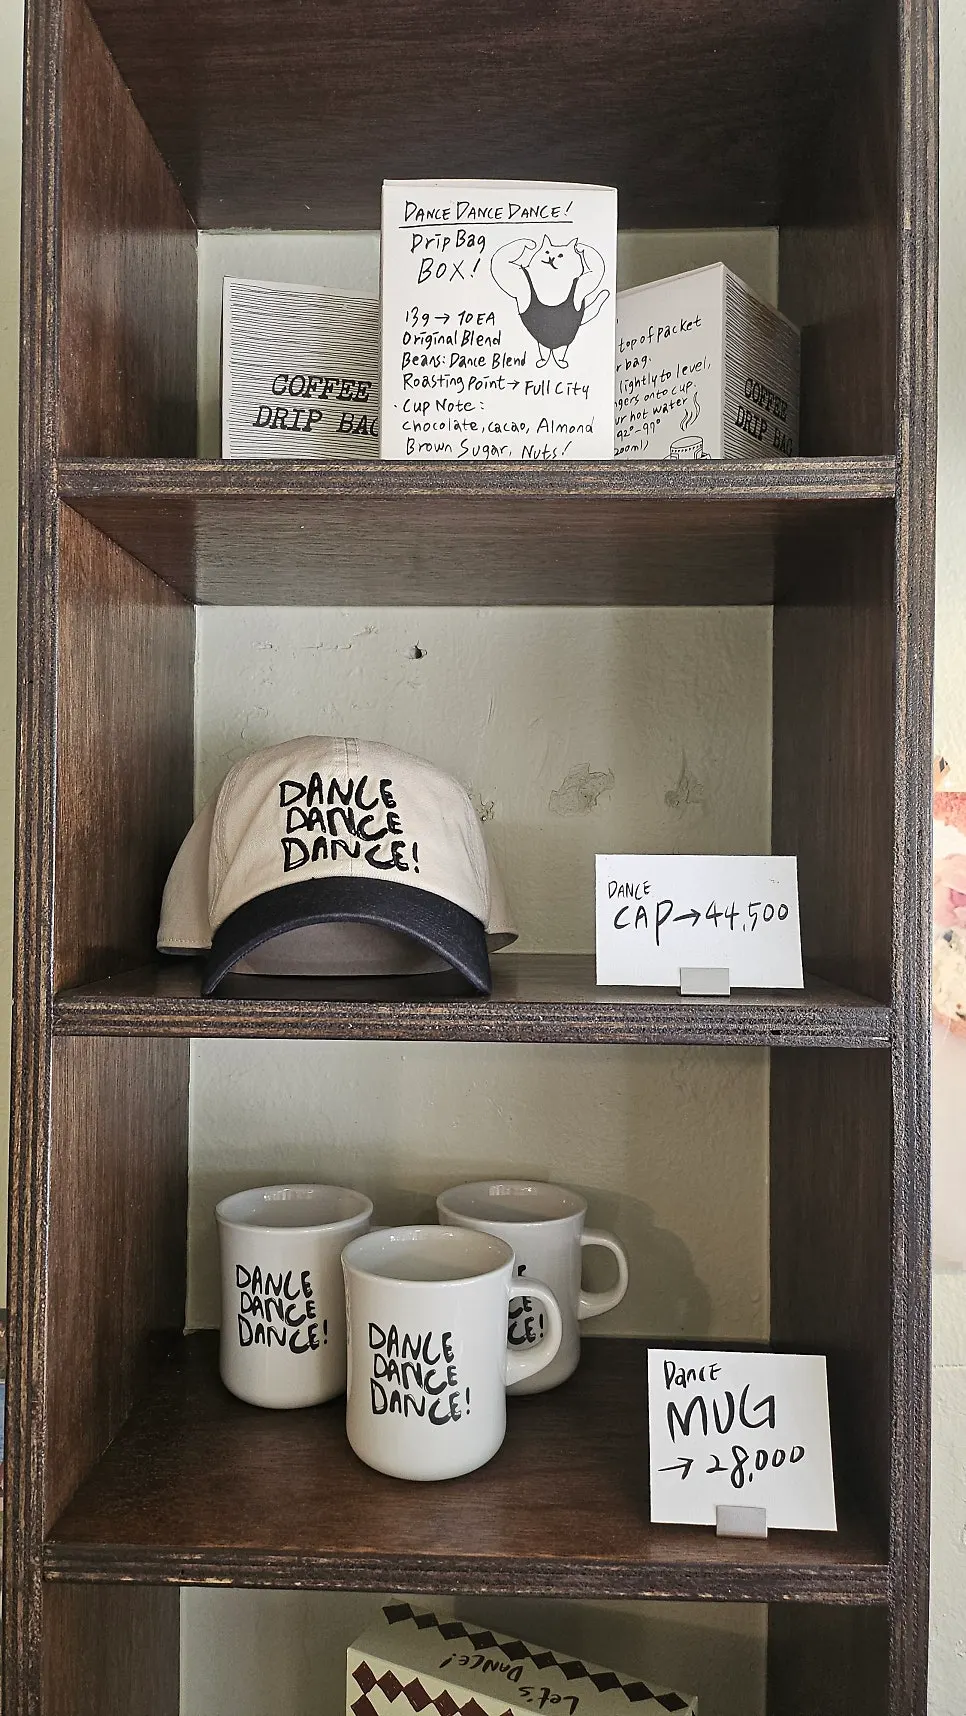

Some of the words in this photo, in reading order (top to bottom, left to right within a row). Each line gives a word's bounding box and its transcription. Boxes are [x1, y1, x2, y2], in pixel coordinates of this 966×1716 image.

[404, 200, 451, 222] DANCE
[456, 200, 503, 220] DANCE
[508, 201, 574, 219] DANCE!
[411, 233, 451, 253] Drip
[456, 229, 486, 253] Bag
[418, 258, 481, 284] BOX!
[405, 306, 430, 327] 13g
[402, 330, 458, 350] Original
[461, 330, 502, 347] Blend
[619, 337, 637, 353] top
[640, 326, 654, 344] of
[657, 315, 702, 343] packet
[401, 352, 446, 371] Beans:
[449, 353, 487, 369] Dance
[492, 351, 527, 369] Blend
[271, 374, 373, 403] COFFEE
[403, 373, 465, 393] Roasting
[468, 375, 506, 390] Point
[525, 379, 551, 396] Full
[555, 381, 590, 400] City
[619, 374, 658, 394] lightly
[660, 369, 672, 382] to
[403, 399, 431, 416] Cup
[629, 408, 649, 422] hot
[653, 397, 688, 413] water
[744, 377, 788, 422] COFFEE
[252, 405, 323, 433] DRIP
[537, 416, 595, 434] Almond
[735, 405, 768, 441] DRIP
[406, 437, 453, 456] Brown
[521, 441, 573, 460] Nuts!
[279, 772, 397, 811] DANCE
[286, 806, 404, 841] DANCE
[281, 836, 420, 874] DANCE!
[608, 880, 652, 901] DANCE
[613, 899, 674, 947] CAP
[705, 900, 790, 932] 44,500
[235, 1263, 314, 1301] DANCE
[240, 1291, 317, 1328] DANCE
[237, 1313, 329, 1354] DANCE!
[368, 1322, 455, 1366] DANCE
[374, 1353, 459, 1396] DANCE
[370, 1378, 471, 1426] DANCE!
[666, 1383, 776, 1444] MUG
[705, 1445, 805, 1489] 28,000
[439, 1653, 524, 1682] DANCE!
[518, 1686, 580, 1716] Let's
